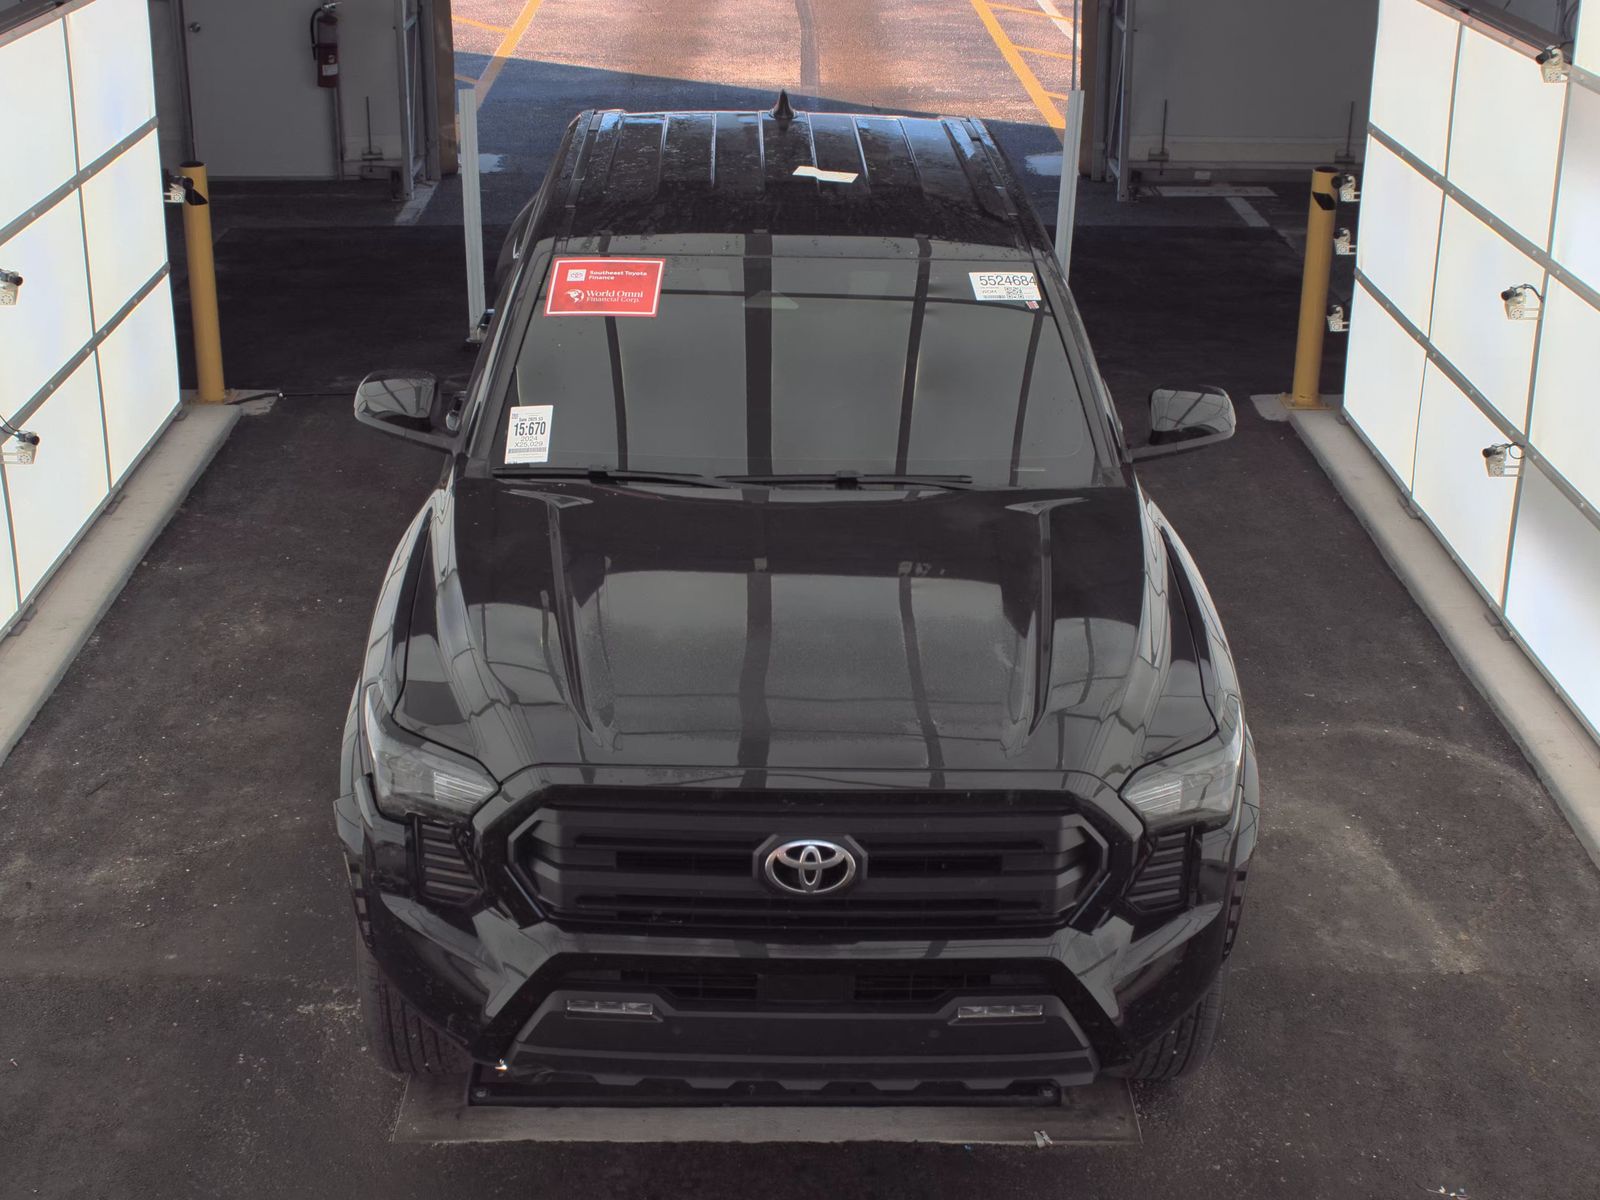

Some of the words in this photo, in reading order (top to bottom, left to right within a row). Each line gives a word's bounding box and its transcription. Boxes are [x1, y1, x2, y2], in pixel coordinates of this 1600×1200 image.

[979, 275, 1037, 286] 5524684
[586, 290, 615, 298] World
[514, 422, 546, 436] 15:670
